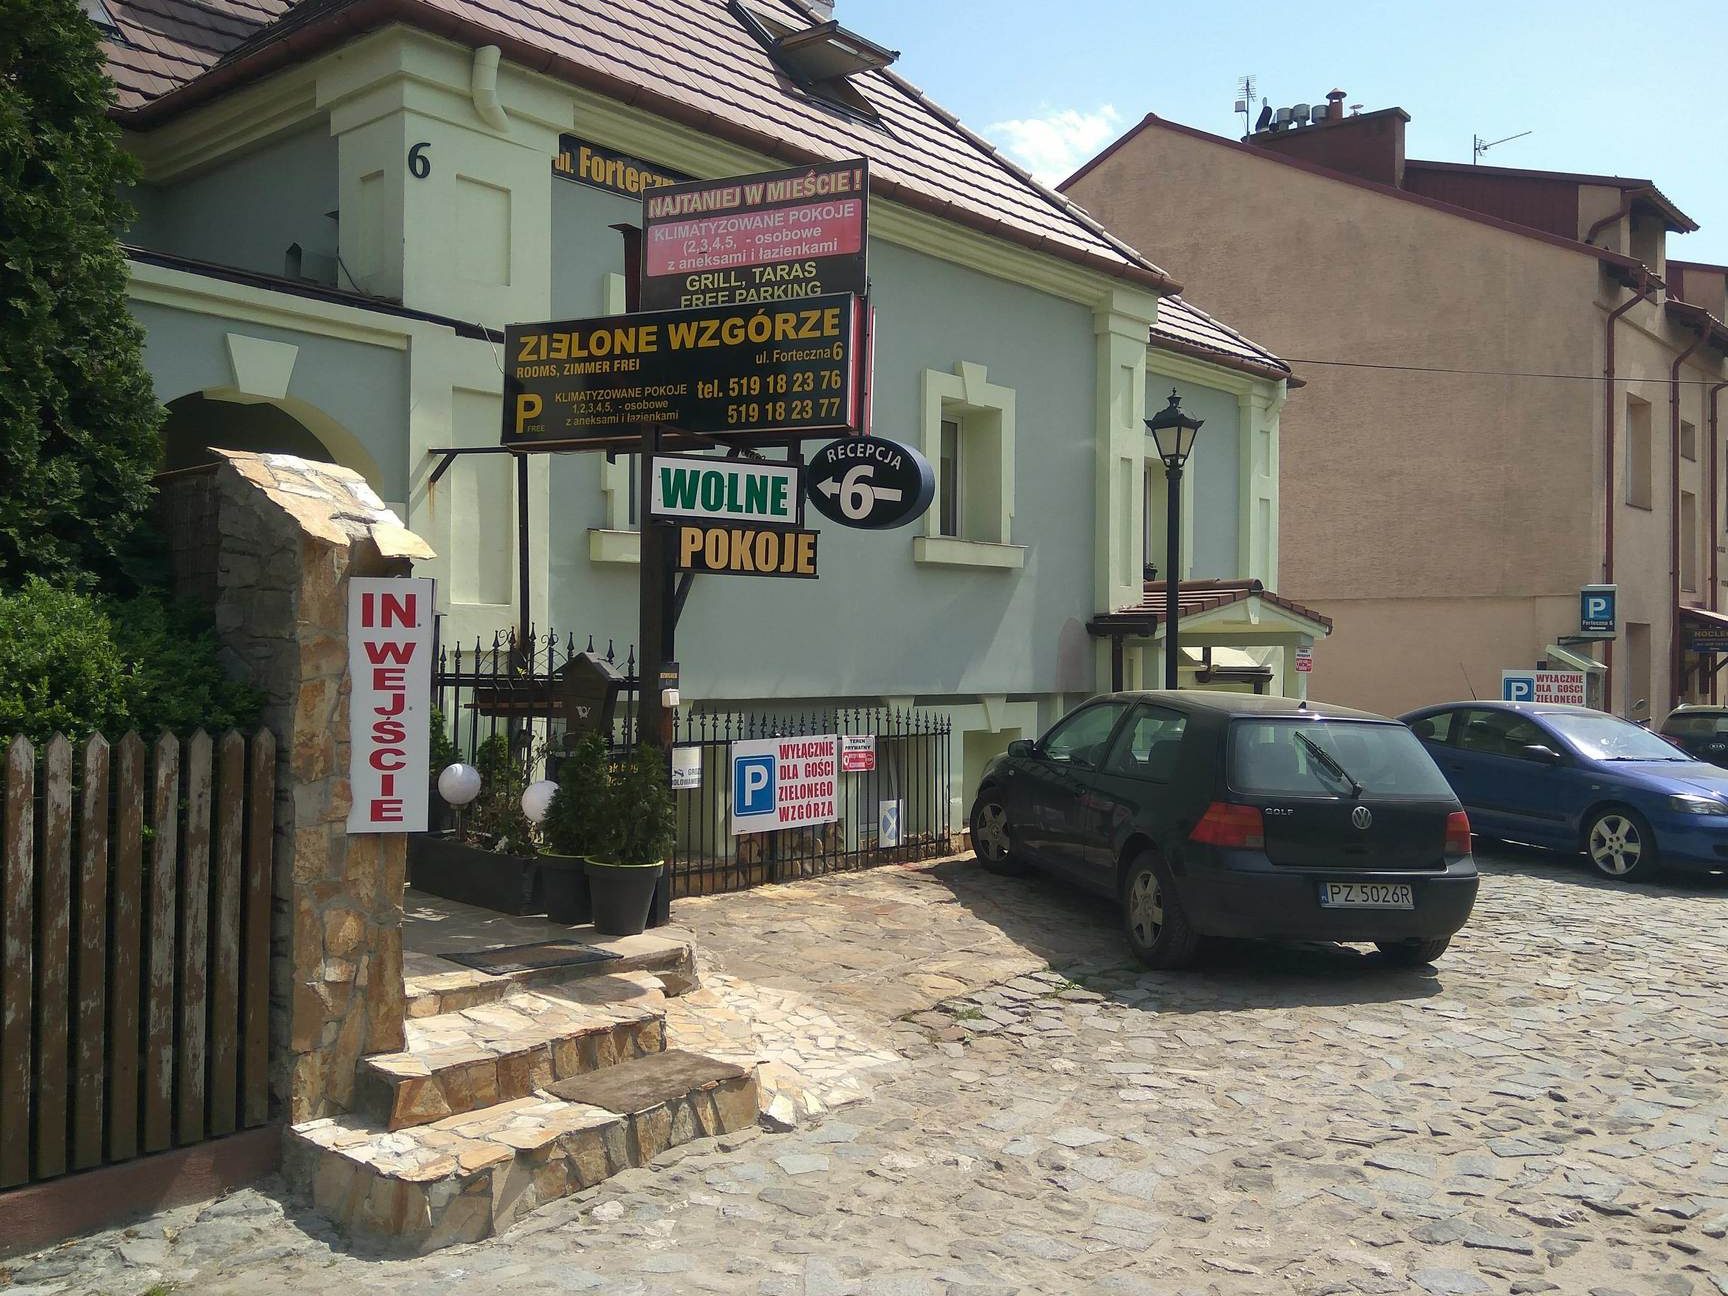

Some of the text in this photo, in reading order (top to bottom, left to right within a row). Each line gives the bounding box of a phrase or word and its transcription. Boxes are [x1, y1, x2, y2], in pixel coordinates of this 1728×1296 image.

[408, 142, 431, 178] 6
[579, 146, 676, 193] Fortecz
[648, 186, 741, 219] NAJTANIEJ
[744, 182, 765, 205] W
[767, 169, 851, 203] MIEŚCIE
[653, 203, 855, 242] KLIMATYZOWANE POKOJE
[754, 226, 822, 245] osobowe
[667, 238, 838, 271] z aneksami i łazienkami
[686, 261, 817, 291] GRILL, TARAS
[735, 281, 822, 304] PARKING
[667, 307, 840, 351] WZGÓRZE
[756, 341, 843, 364] ul. Forteczna 6
[516, 358, 640, 379] ROOMS, ZIMMER FREI
[555, 383, 688, 403] KLIMATYZOWANE POKOJE
[697, 369, 842, 399] tel. 519 18 23 76
[515, 393, 545, 434] P FREE
[624, 400, 669, 410] osobowe
[727, 397, 841, 424] 519 18 23 77
[566, 418, 572, 426] z
[573, 413, 619, 427] aneksami
[626, 409, 679, 423] łazienkami
[827, 443, 902, 471] RECEPCJA
[661, 467, 788, 516] WOLNE
[839, 465, 875, 520] 6
[680, 527, 816, 574] POKOJE
[361, 592, 417, 629] IN
[1589, 598, 1606, 619] P
[1536, 674, 1583, 684] WYŁĄCZNIE
[1536, 684, 1583, 693] DLA GOŚCI
[1536, 695, 1583, 704] ZIELONEGO
[363, 641, 417, 822] WEJŚCIE
[779, 741, 834, 760] WYŁĄCZNIE
[779, 764, 799, 780] DLA
[804, 759, 834, 778] GOŚCI
[744, 764, 769, 807] P
[778, 781, 833, 802] ZIELONEGO
[778, 801, 834, 822] WZGÓRZA
[1264, 807, 1294, 816] GOLF
[1330, 884, 1410, 903] PZ 5026R
